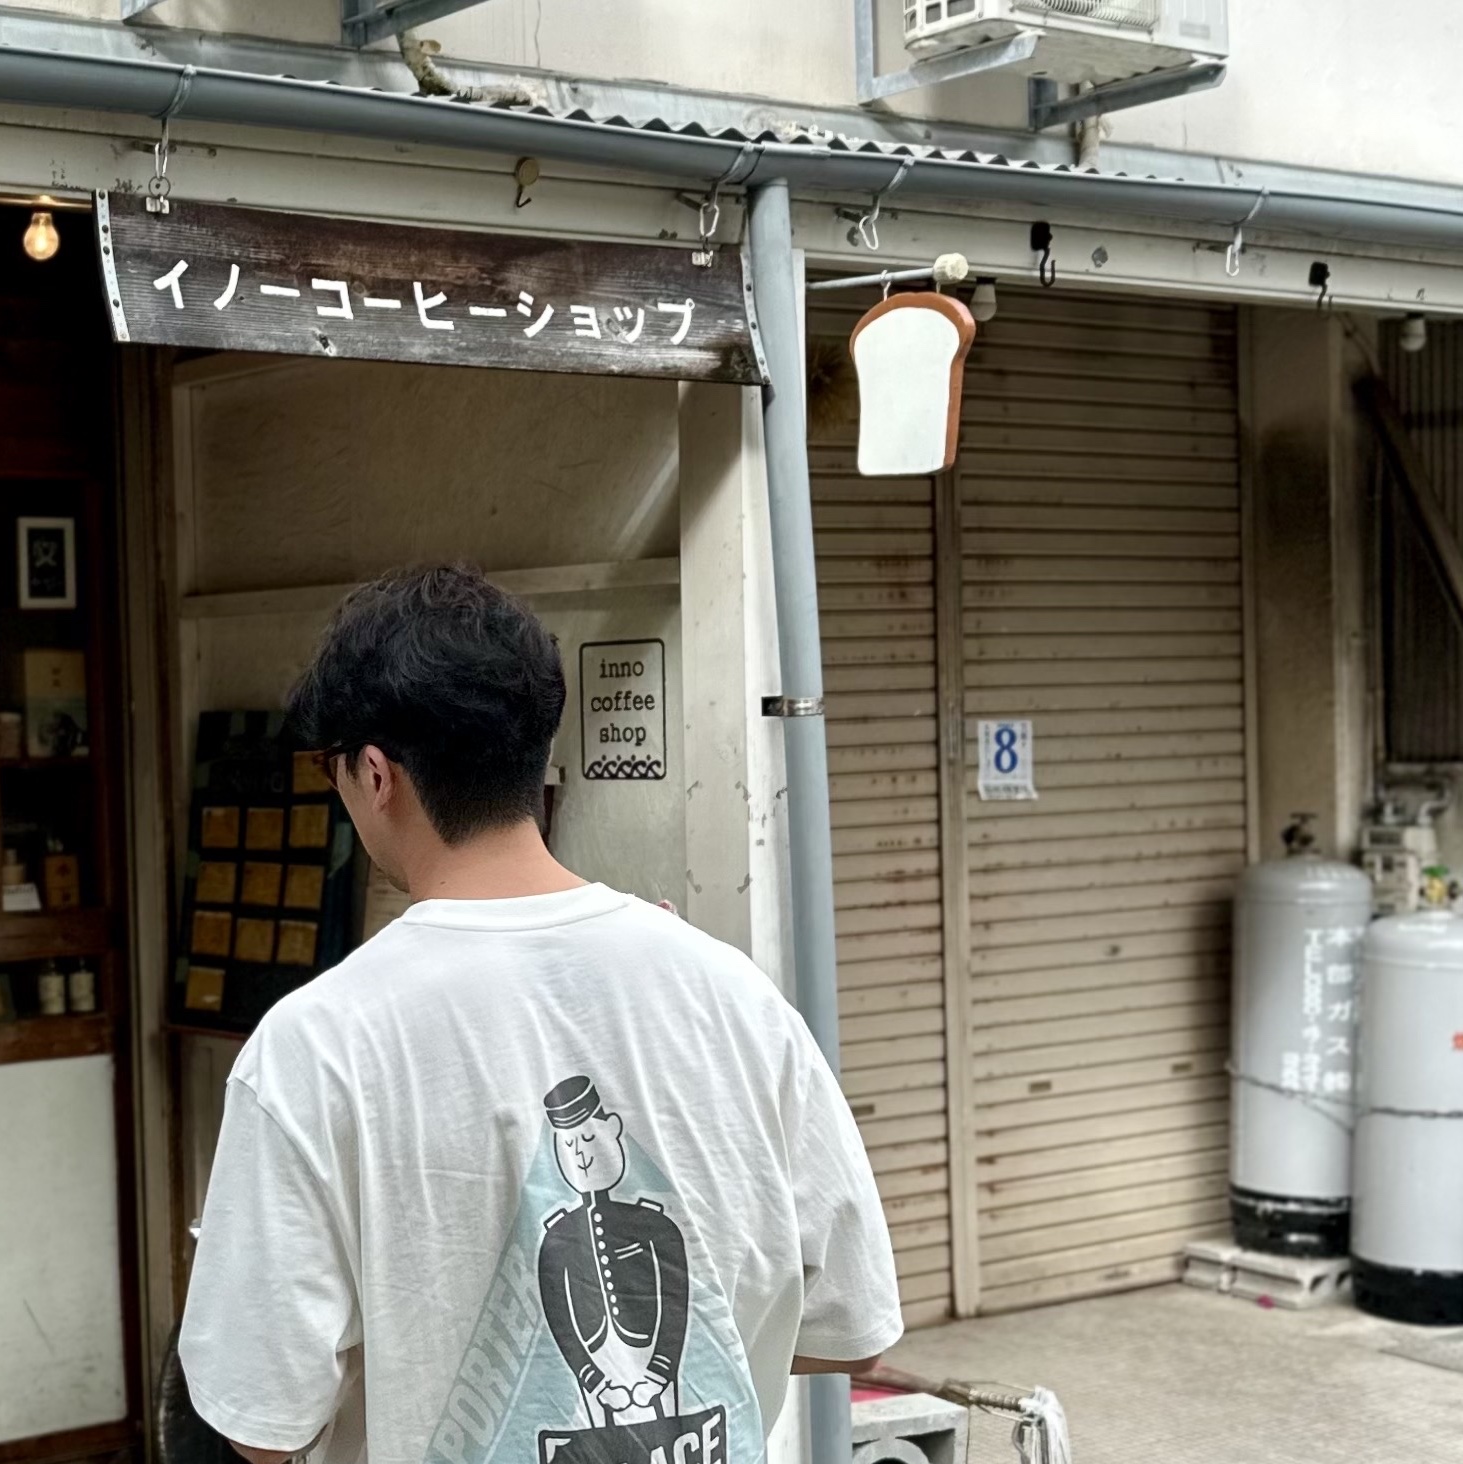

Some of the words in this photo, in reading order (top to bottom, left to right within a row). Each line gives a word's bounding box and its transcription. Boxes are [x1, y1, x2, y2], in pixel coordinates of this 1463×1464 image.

[154, 260, 697, 345] イノーコーヒーショップ
[599, 658, 644, 678] inno
[591, 690, 655, 712] coffee
[599, 723, 646, 746] shop
[993, 726, 1018, 773] 8
